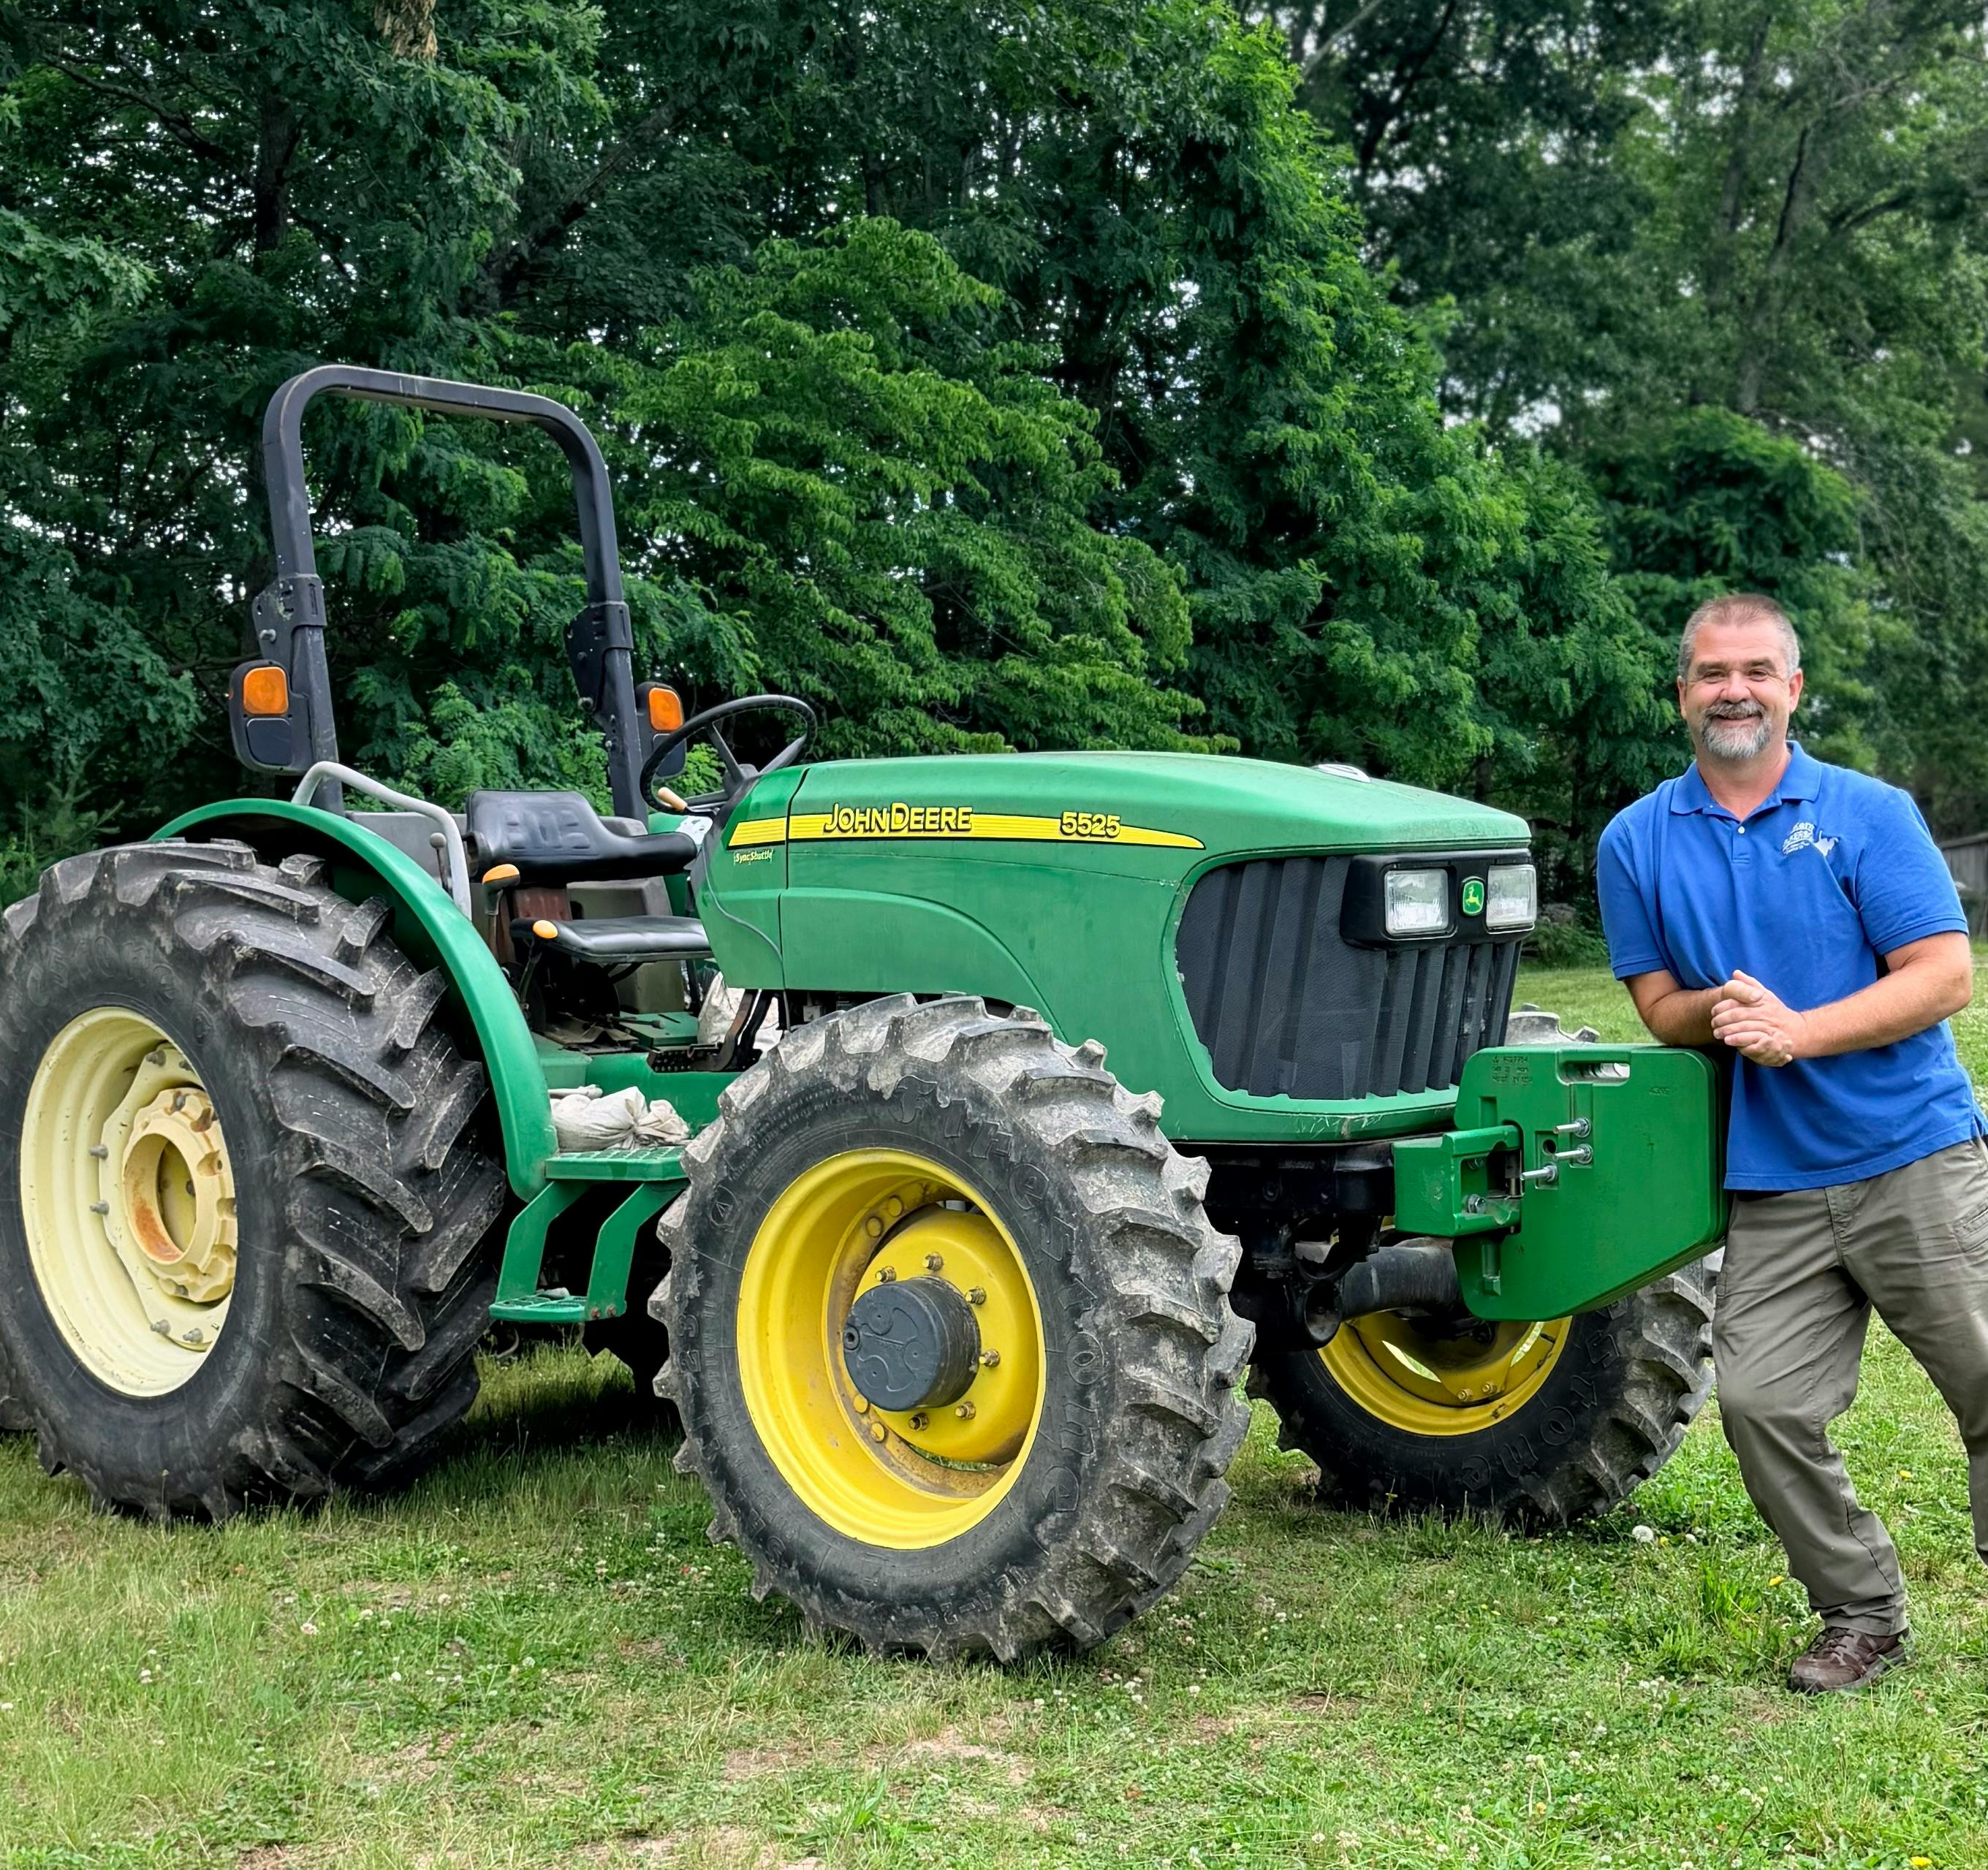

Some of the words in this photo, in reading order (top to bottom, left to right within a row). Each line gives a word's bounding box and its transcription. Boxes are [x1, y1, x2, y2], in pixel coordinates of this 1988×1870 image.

[824, 802, 889, 833] JOHN
[890, 802, 974, 832] DEERE
[1060, 810, 1121, 837] 5525
[887, 1074, 1106, 1513] Firestone
